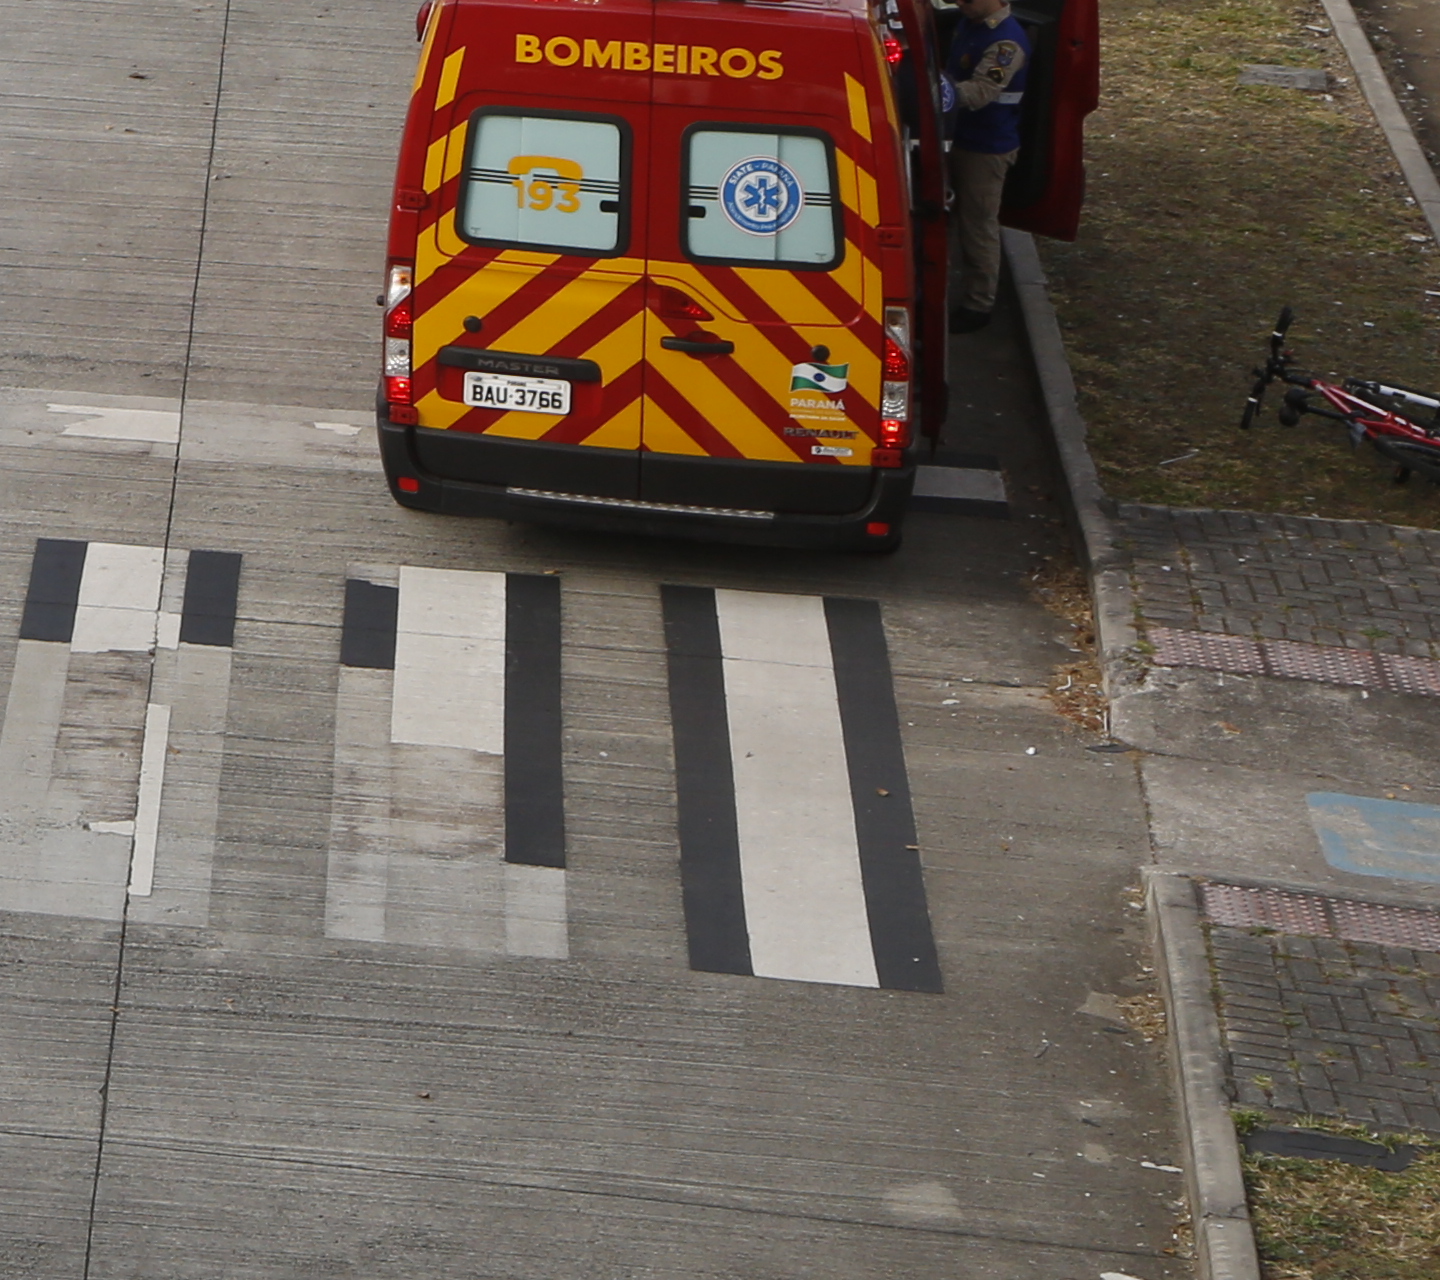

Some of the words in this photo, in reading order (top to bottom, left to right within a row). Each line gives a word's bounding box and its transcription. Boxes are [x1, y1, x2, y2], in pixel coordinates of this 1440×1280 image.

[514, 33, 785, 81] BOMBEIROS
[729, 162, 756, 187] SIATE
[512, 180, 582, 214] 193
[477, 358, 560, 376] MASTER
[472, 384, 563, 409] BAU-3766
[790, 398, 846, 411] PARANÁ
